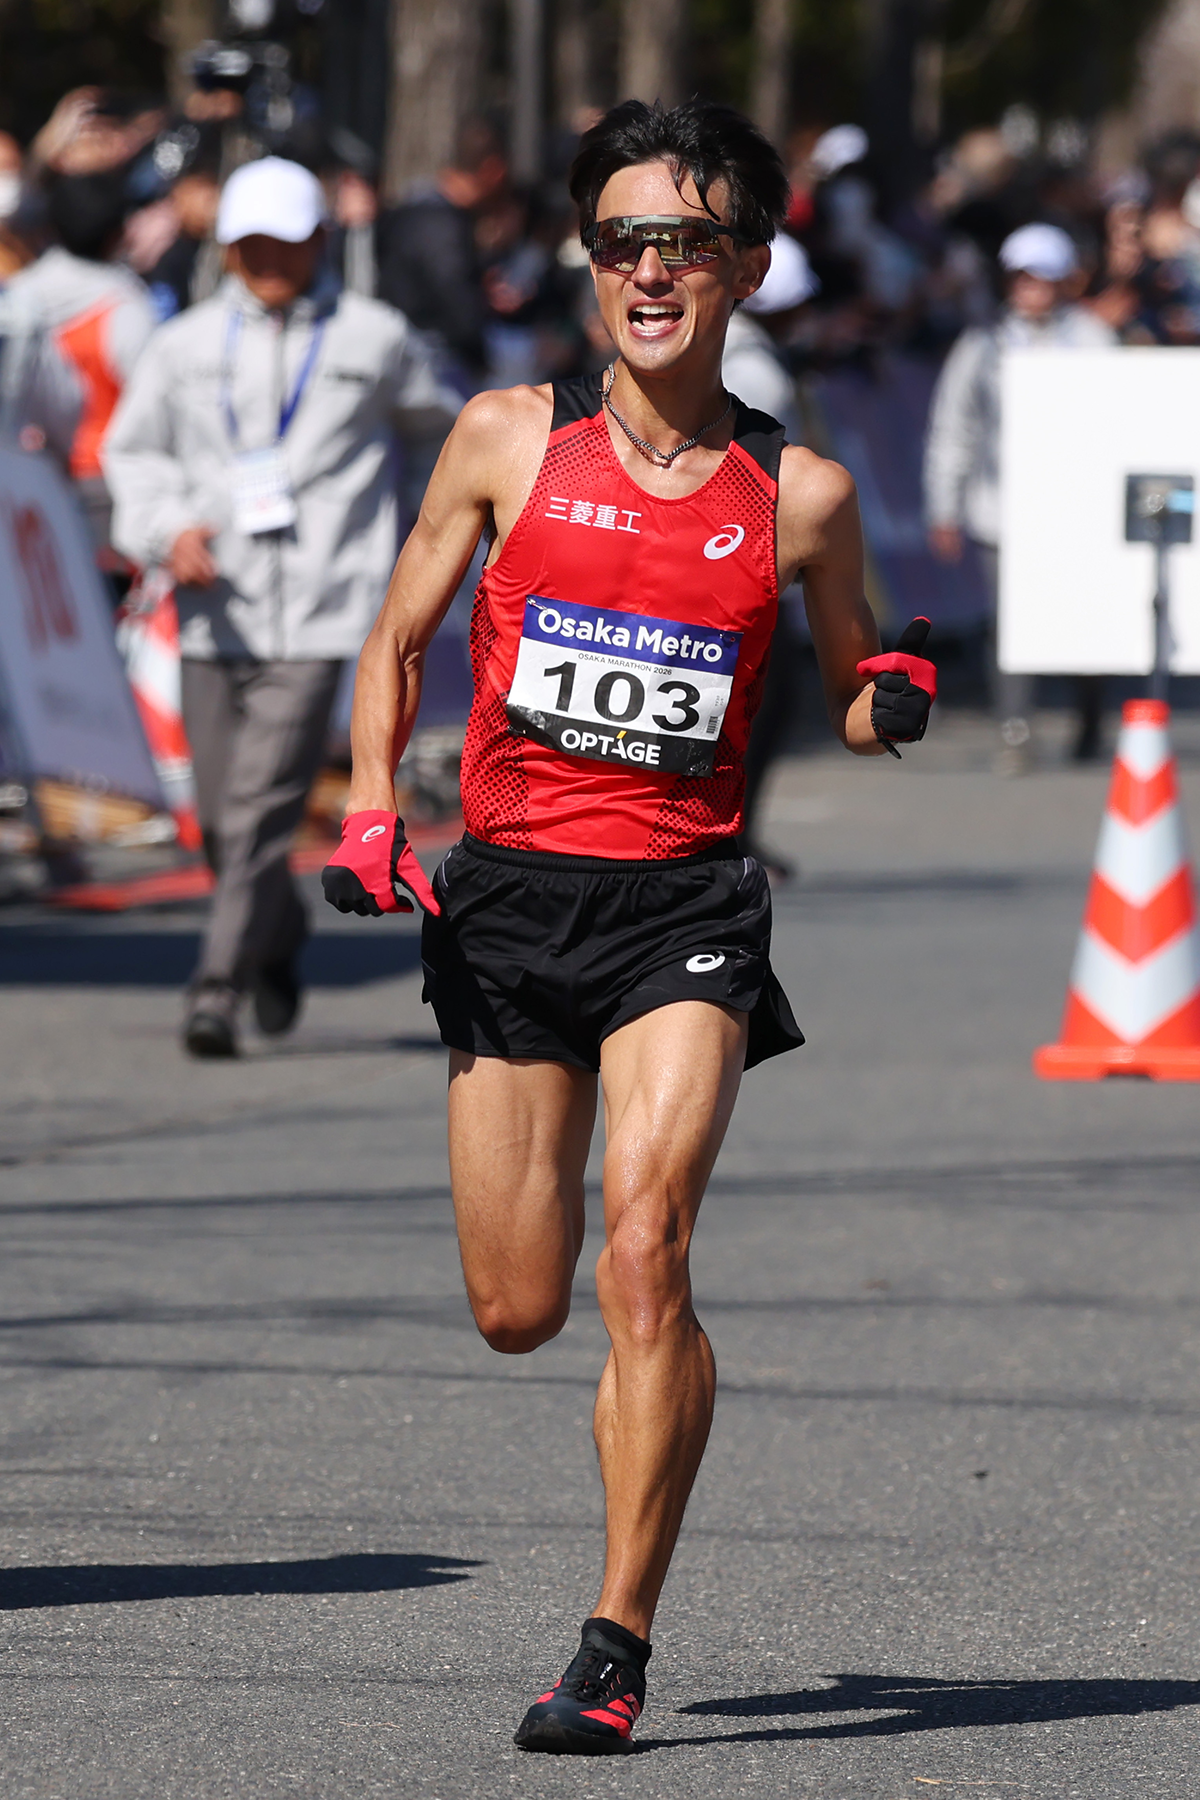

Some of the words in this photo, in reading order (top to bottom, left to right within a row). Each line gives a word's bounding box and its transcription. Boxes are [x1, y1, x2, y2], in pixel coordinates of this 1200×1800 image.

[545, 496, 642, 534] 三菱重工
[537, 608, 631, 648] Osaka
[635, 626, 723, 663] Metro
[578, 652, 606, 664] OSAKA
[607, 658, 652, 672] MARATHON
[653, 666, 672, 676] 2026
[543, 661, 701, 733] 103
[560, 730, 661, 766] OPTAGE
